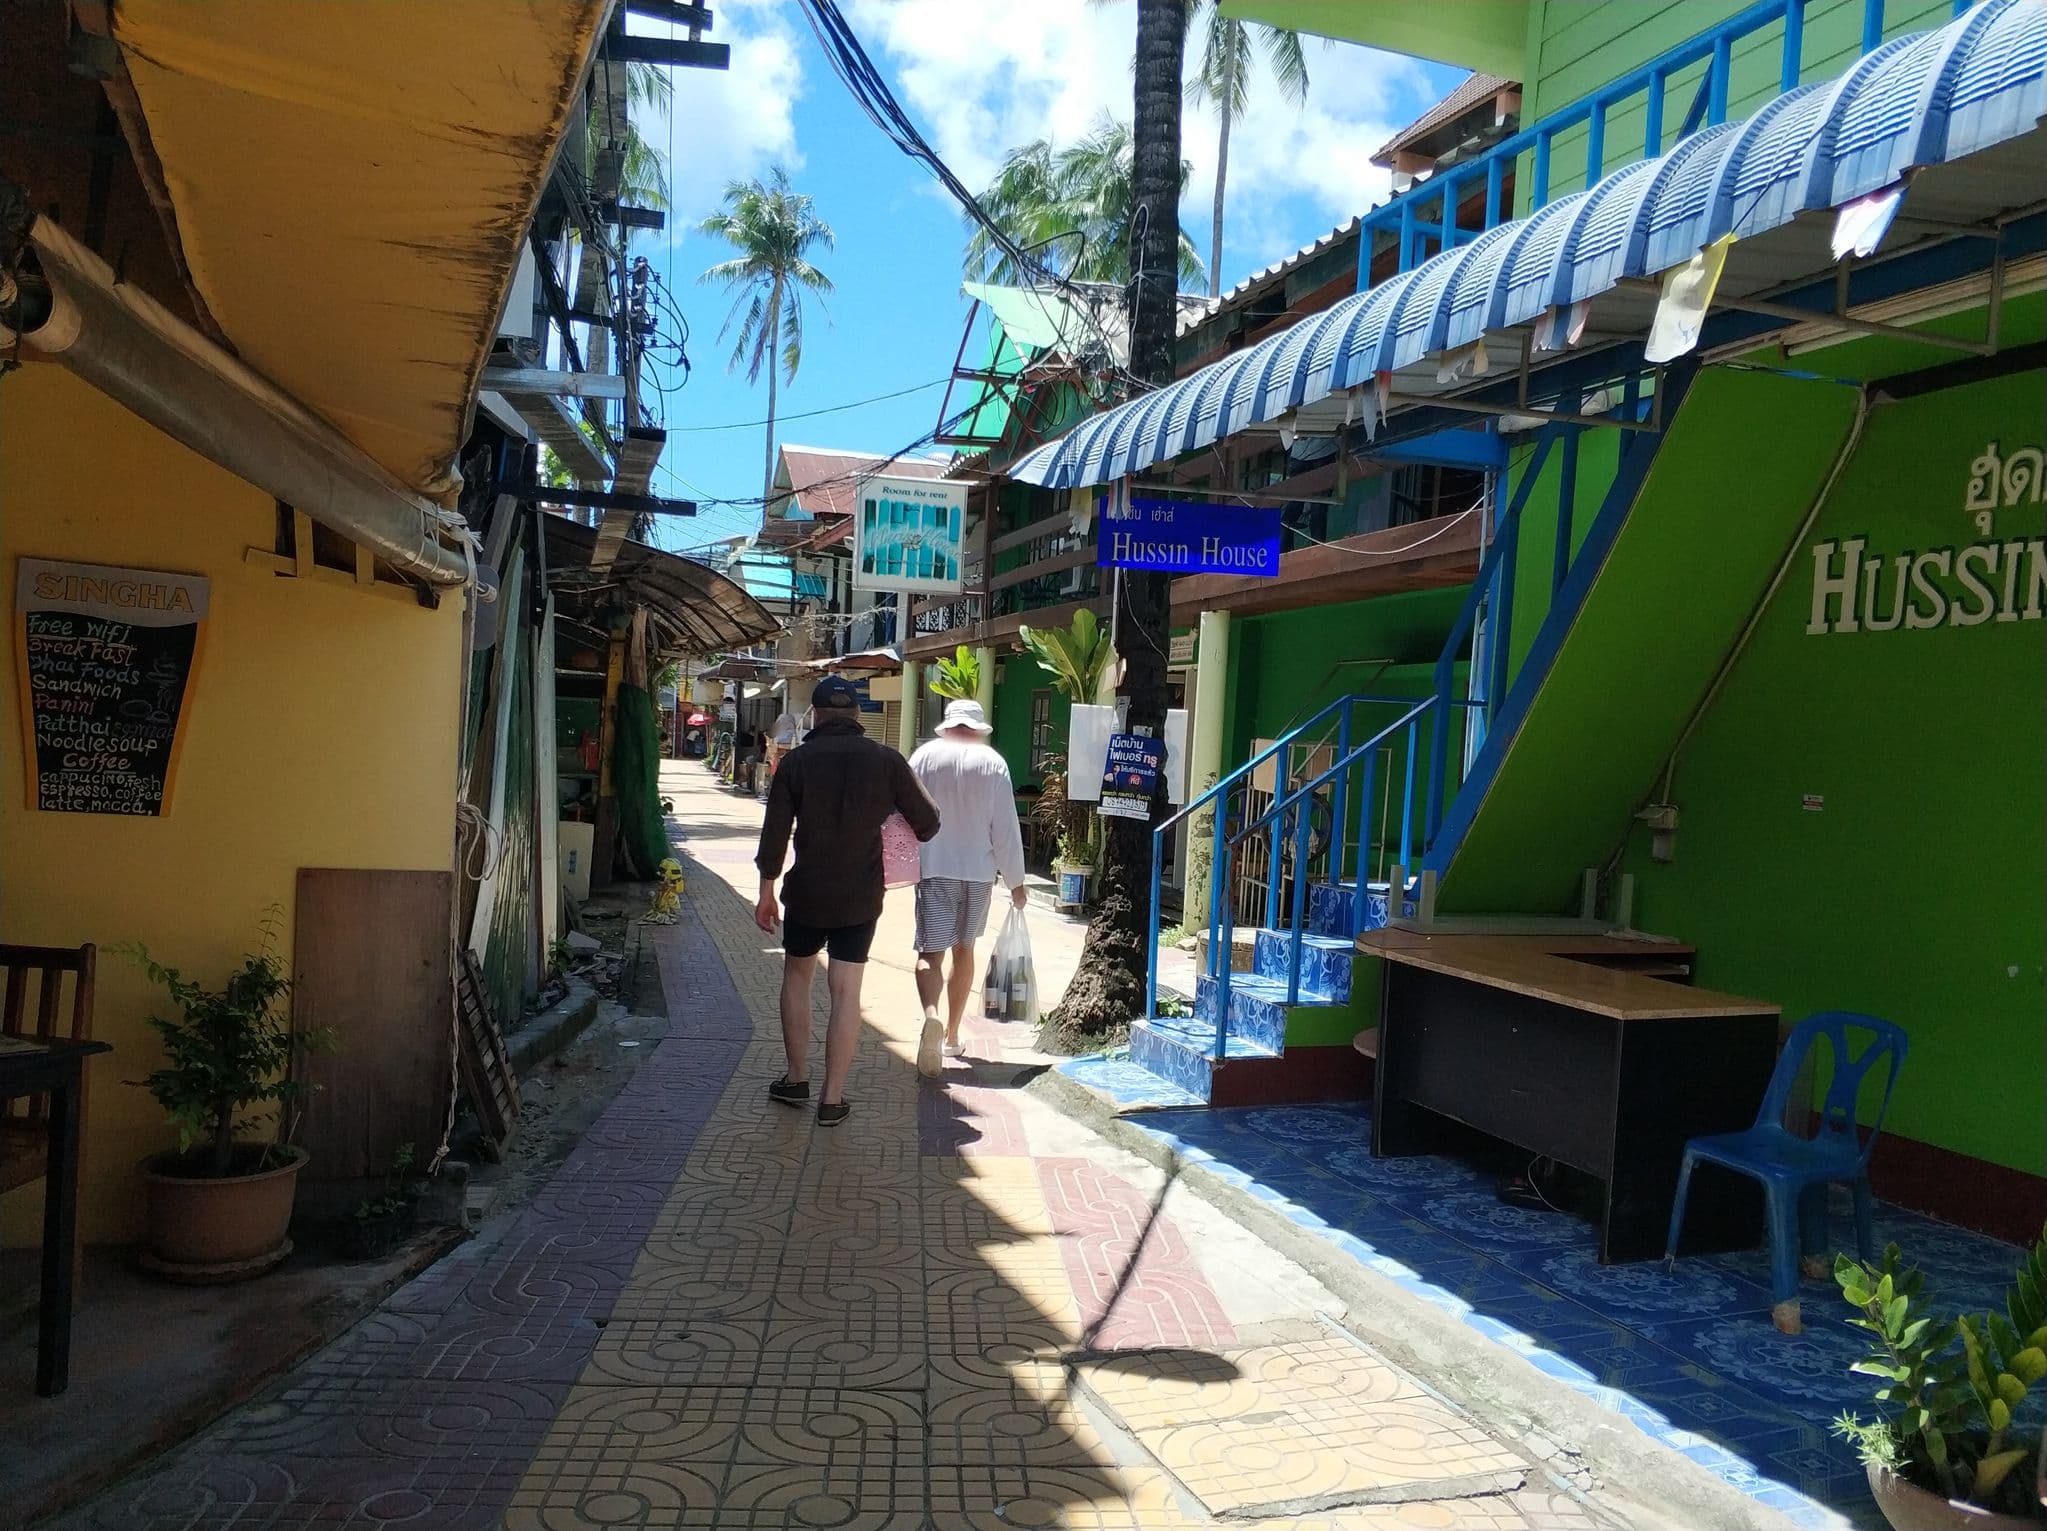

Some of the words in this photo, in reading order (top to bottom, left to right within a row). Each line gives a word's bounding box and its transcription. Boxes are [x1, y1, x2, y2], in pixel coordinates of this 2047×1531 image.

[882, 485, 911, 496] Room
[913, 489, 927, 497] for
[929, 491, 948, 499] rent
[1111, 532, 1189, 566] Hussin
[1200, 535, 1268, 568] House
[33, 572, 195, 613] SINGHA
[29, 614, 73, 636] Free
[32, 673, 122, 700] Sandwich
